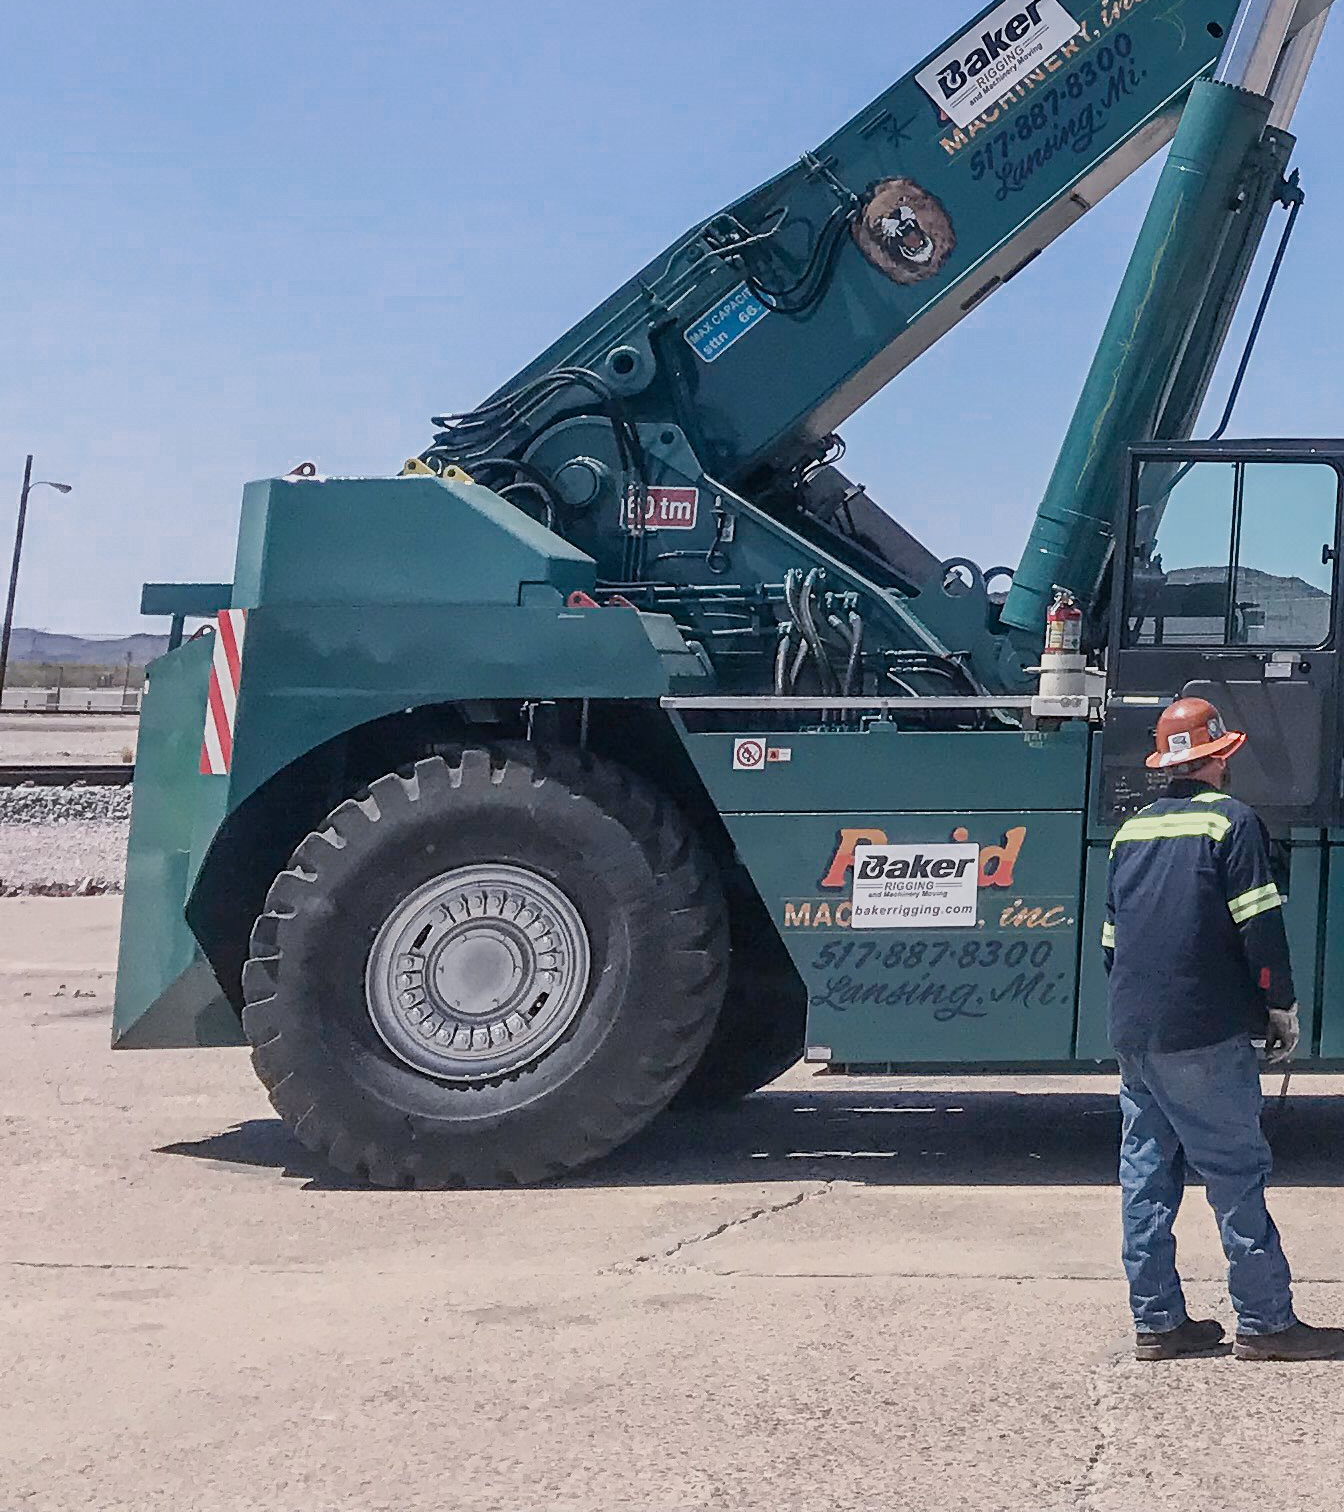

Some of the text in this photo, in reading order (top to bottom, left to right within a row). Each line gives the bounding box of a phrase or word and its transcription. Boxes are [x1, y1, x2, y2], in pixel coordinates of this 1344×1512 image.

[969, 42, 1044, 106] and Machinery Moving
[975, 44, 1025, 89] RIGGING
[688, 287, 753, 344] MAX CAPACIT
[660, 497, 692, 520] tm
[857, 854, 976, 879] Baker
[884, 881, 935, 891] RIGGING
[855, 904, 973, 917] bakerrigging.com
[1000, 898, 1074, 928] inc.
